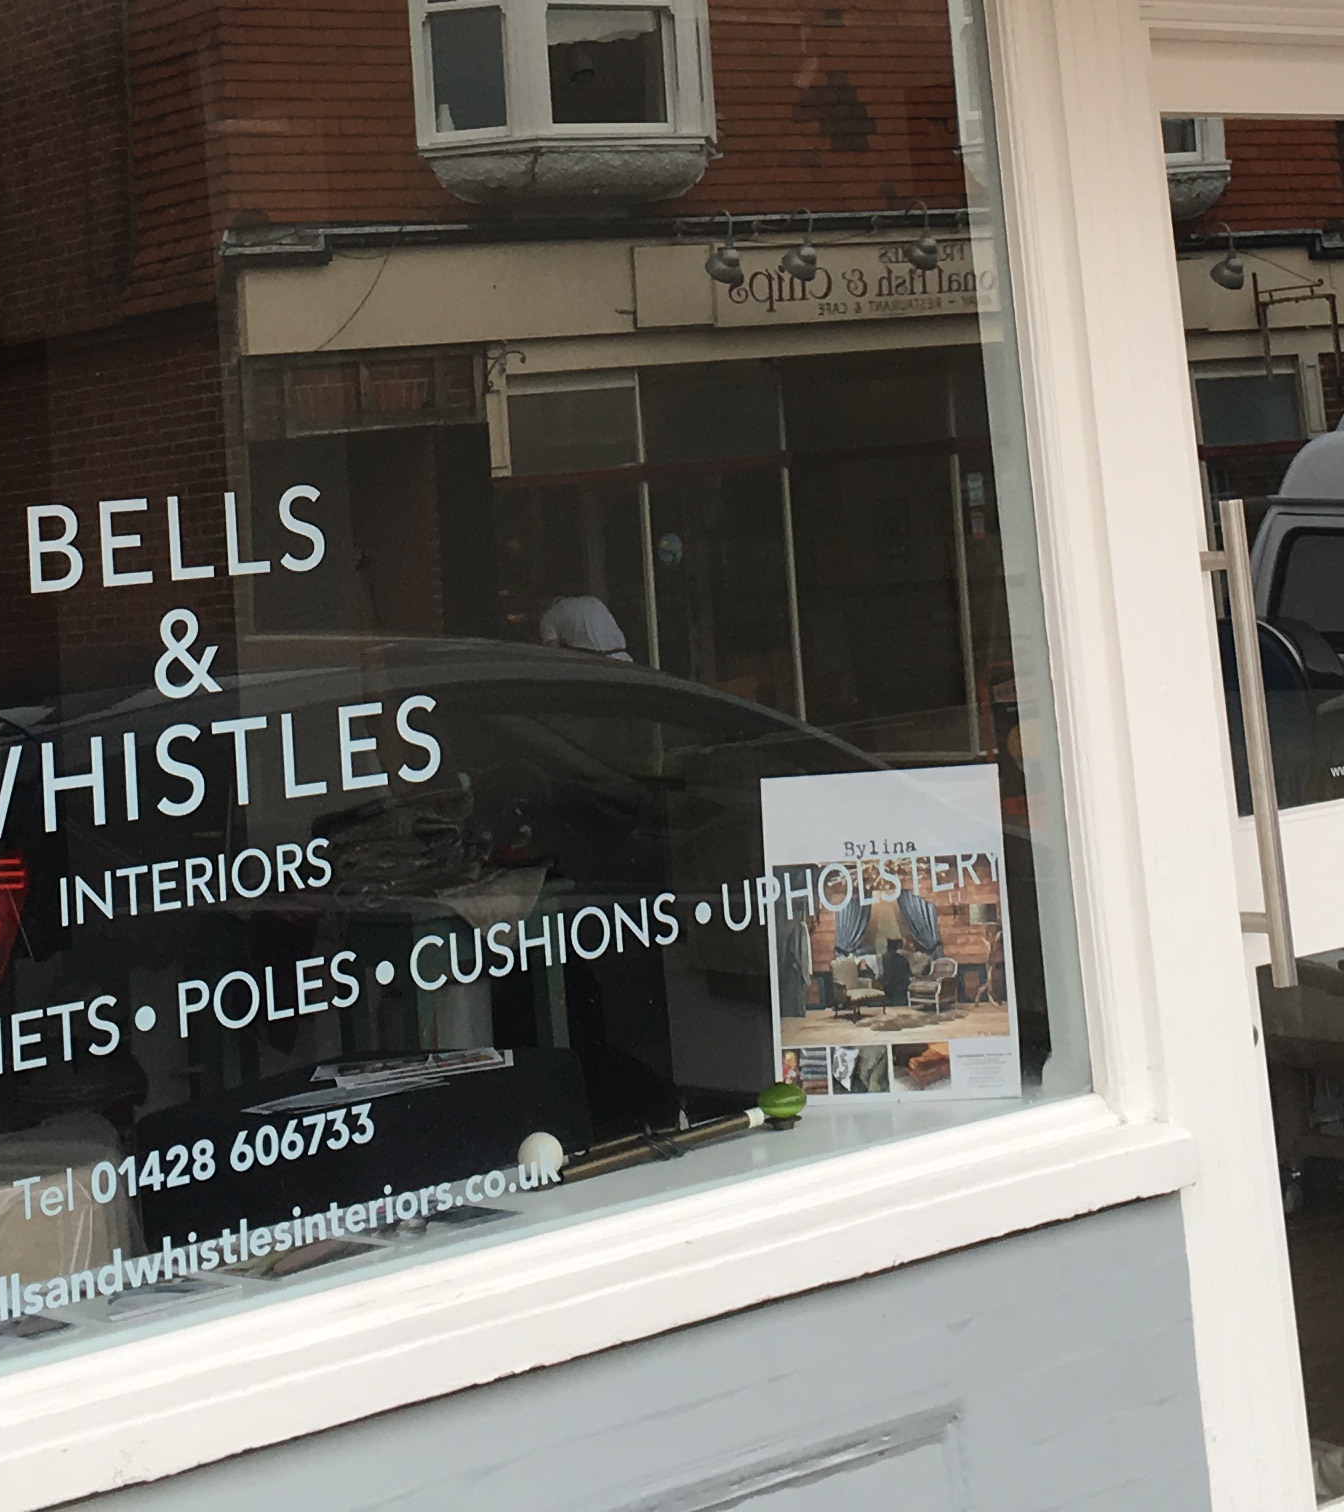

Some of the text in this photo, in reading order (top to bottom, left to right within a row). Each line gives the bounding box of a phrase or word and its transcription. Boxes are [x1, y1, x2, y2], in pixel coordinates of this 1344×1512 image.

[26, 484, 327, 595] BELLS
[153, 607, 223, 700] &
[58, 837, 333, 928] INTERIORS
[842, 838, 918, 859] Bylina
[177, 949, 361, 1040] POLES
[408, 892, 680, 992] CUSHIONS
[721, 851, 1001, 932] UPHOLSTERY
[14, 1101, 376, 1222] Tel 01428 606733
